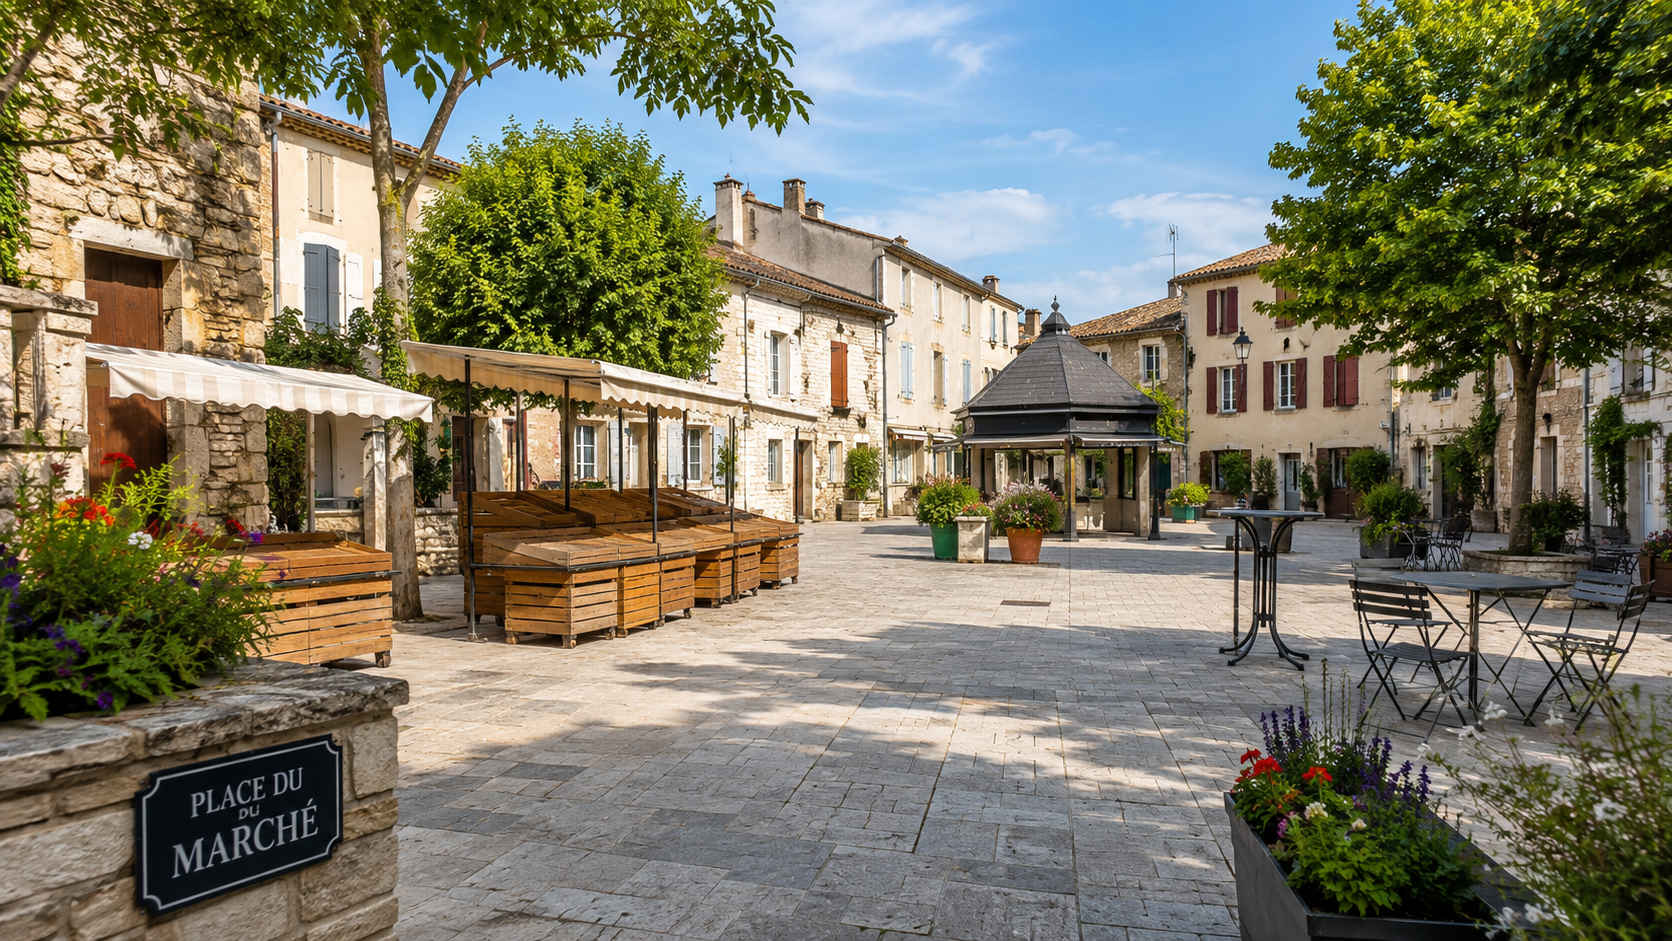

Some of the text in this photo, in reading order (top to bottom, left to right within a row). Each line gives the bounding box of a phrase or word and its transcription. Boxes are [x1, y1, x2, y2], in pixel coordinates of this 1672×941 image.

[190, 767, 303, 818] PLACE DU
[238, 804, 260, 820] DU
[171, 798, 318, 879] MARCHÉ
